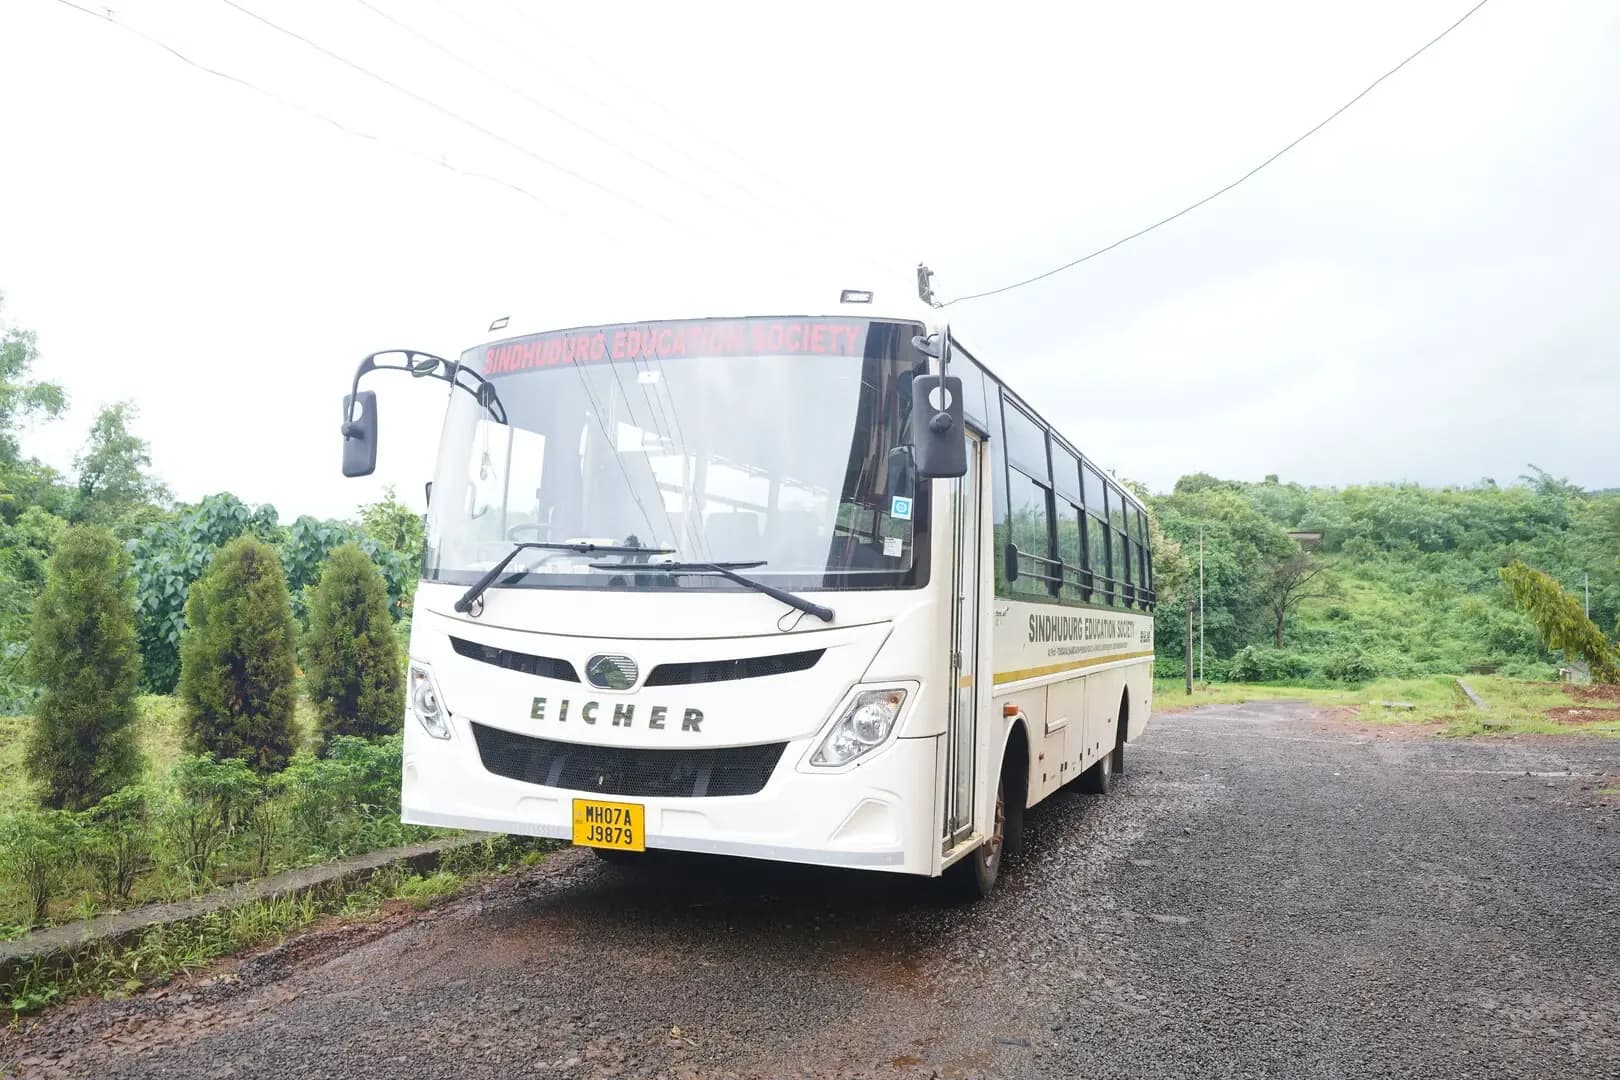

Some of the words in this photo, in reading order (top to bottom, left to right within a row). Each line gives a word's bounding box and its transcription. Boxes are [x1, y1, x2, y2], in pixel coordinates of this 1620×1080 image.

[483, 333, 605, 376] SINDHUDURG
[612, 324, 745, 359] EDUCATION
[752, 321, 862, 354] SOCIETY
[1028, 613, 1083, 642] SINDHUDURG
[1084, 618, 1116, 640] EDUCATION
[1117, 620, 1135, 639] SOCIETY
[530, 696, 705, 732] EICHER
[586, 805, 632, 826] MH07A
[586, 825, 633, 845] J9879
